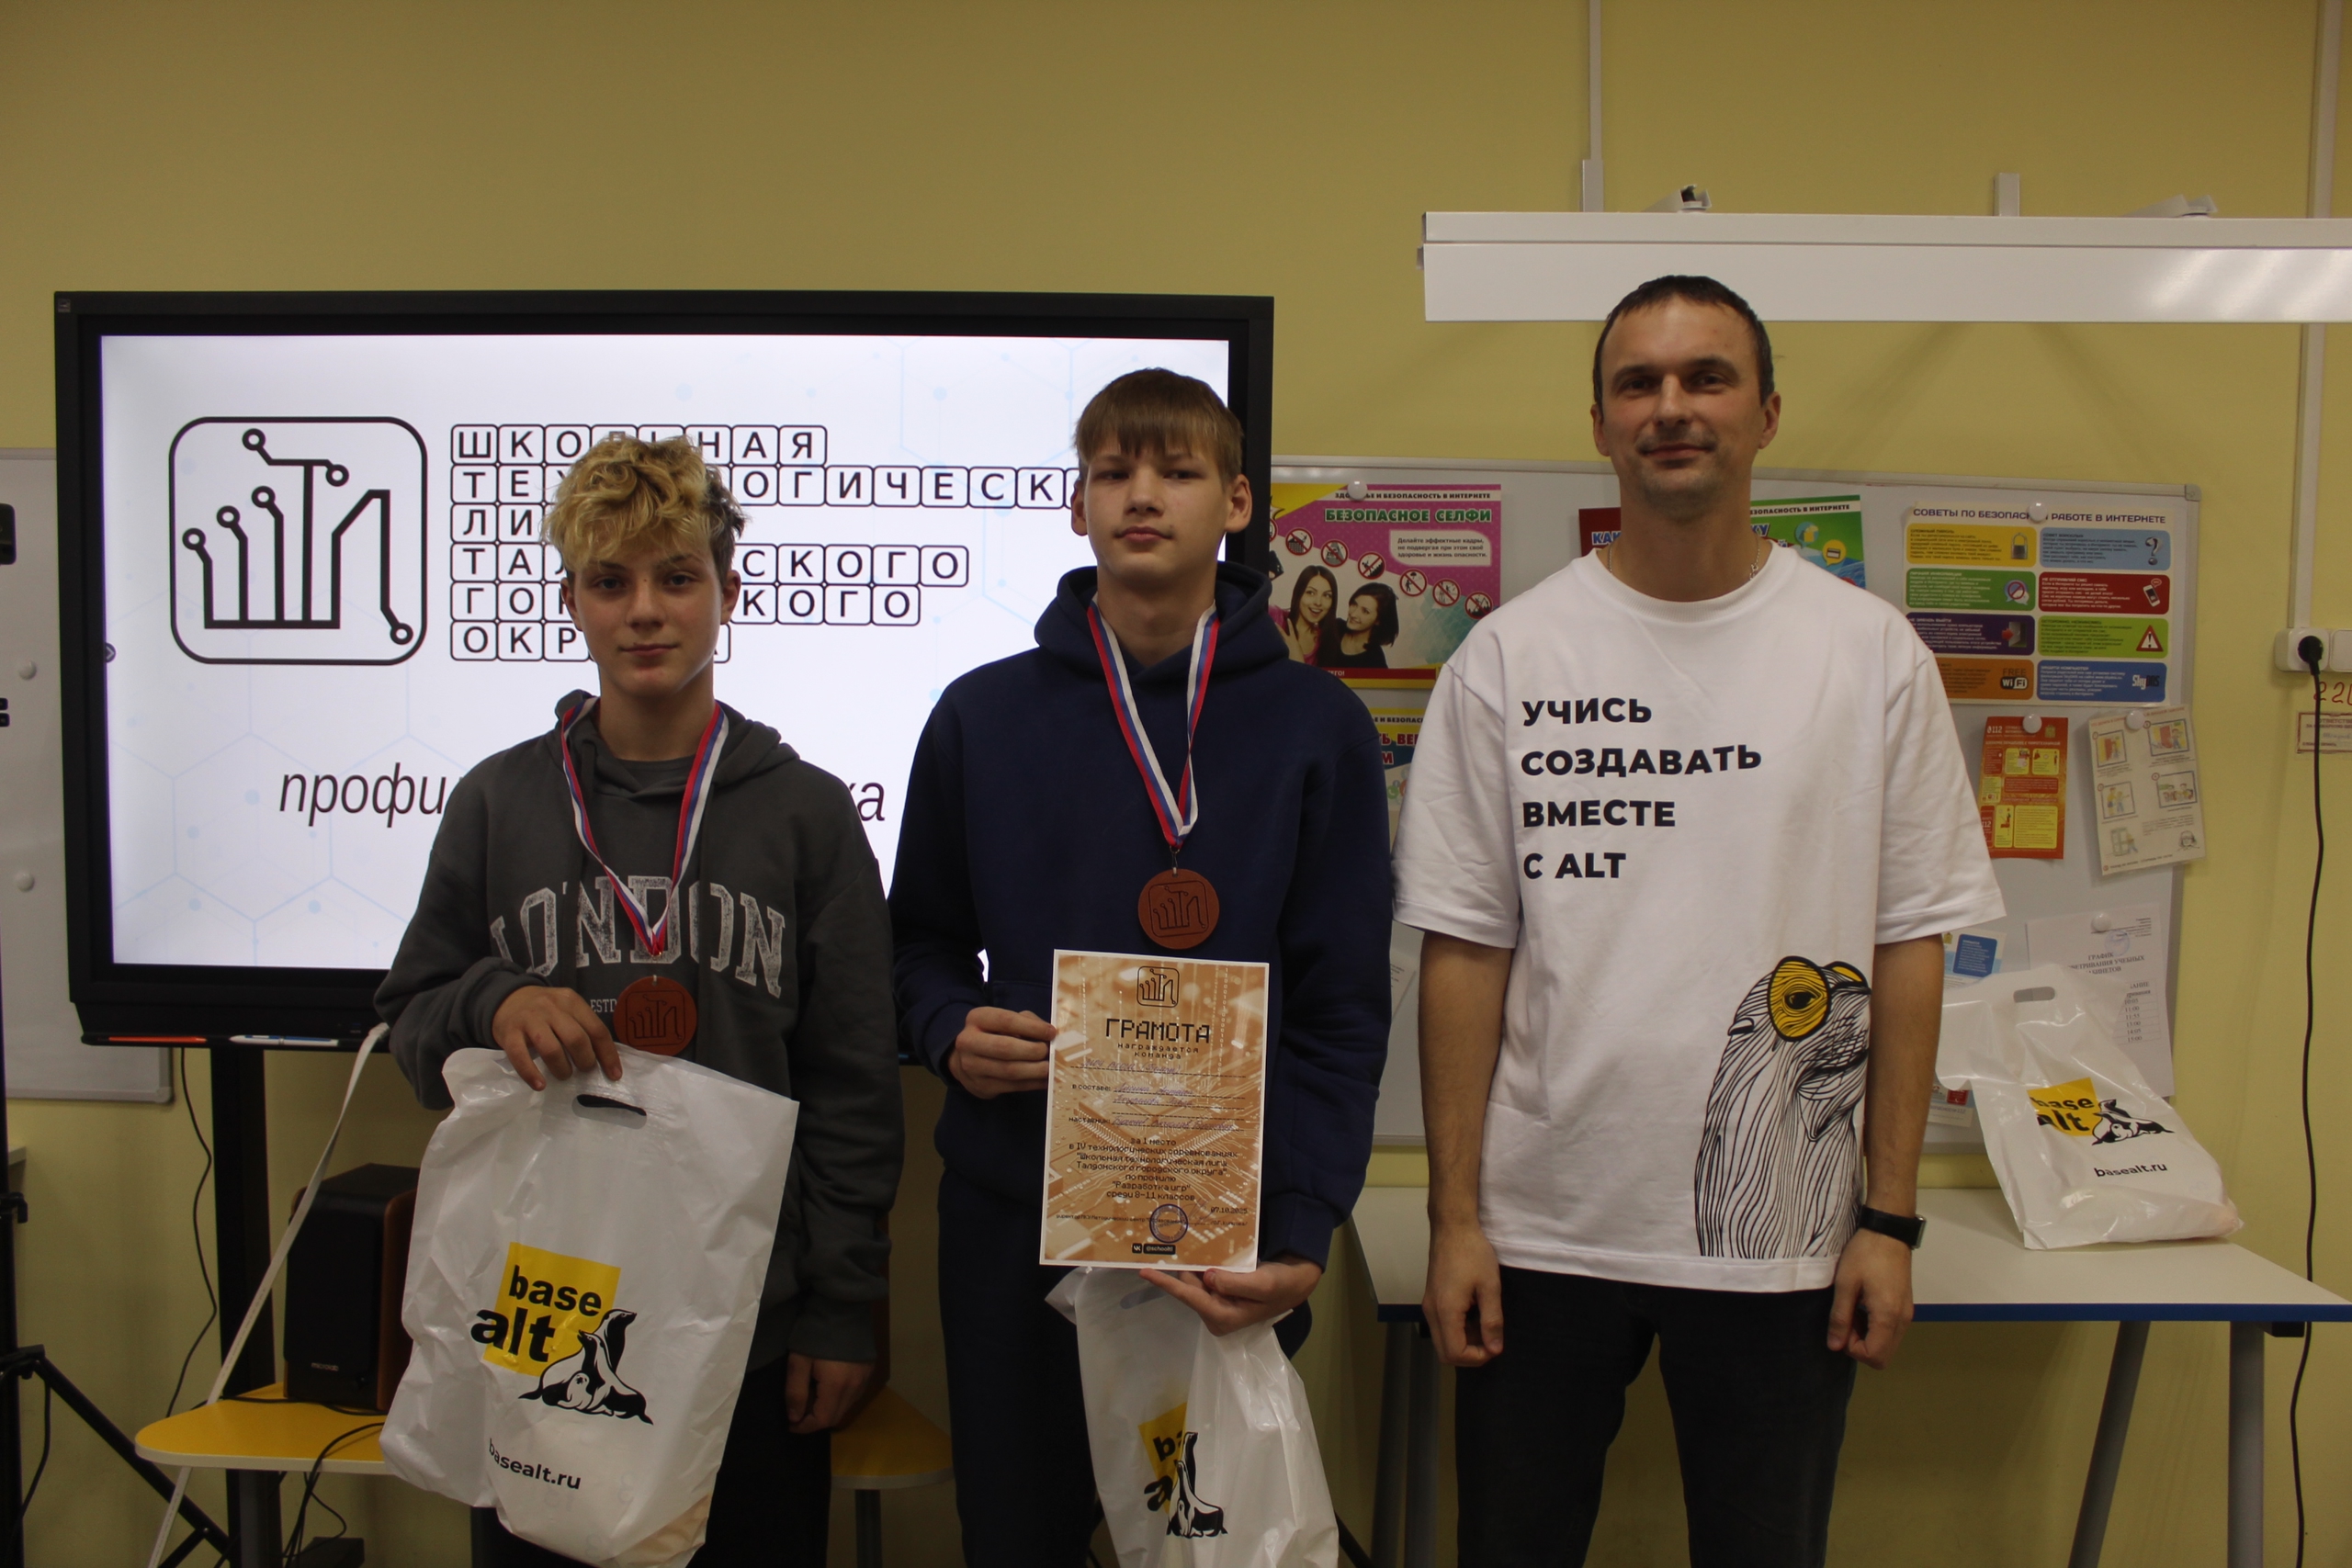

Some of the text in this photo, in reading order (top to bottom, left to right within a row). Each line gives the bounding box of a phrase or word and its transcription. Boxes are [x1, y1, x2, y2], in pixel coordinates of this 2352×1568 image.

[459, 431, 812, 459] ШКОНАЯ
[463, 470, 1053, 502] ТЕОГИЧЕСК
[1325, 509, 1491, 522] БЕЗОПАСНОЕ СЕЛФИ
[1913, 509, 1958, 517] СОВЕТЫ
[2052, 513, 2092, 522] РАБОТЕ
[2106, 514, 2165, 524] ИНТЕРНЕТЕ
[2003, 668, 2027, 676] FREE
[1521, 697, 1652, 727] УЧИСЬ
[1521, 744, 1762, 777] СОЗДАВАТЬ
[279, 763, 447, 828] профи
[1522, 799, 1676, 828] ВМЕСТЕ
[1523, 852, 1626, 879] С ALT
[2088, 953, 2114, 961] ГРАФИК
[2114, 955, 2145, 964] УЧЕБНЫХ
[1106, 1018, 1210, 1043] ГРАМОТА
[1118, 1043, 1199, 1053] награждается
[1135, 1052, 1181, 1060] команда
[2030, 1097, 2095, 1111] base
[1088, 1145, 1166, 1154] технологических
[1168, 1148, 1238, 1157] соревнованиях
[1136, 1166, 1189, 1174] городского
[2094, 1163, 2167, 1178] basealt.ru
[1135, 1190, 1156, 1199] 8-11
[508, 1265, 602, 1316] base
[470, 1307, 556, 1362] alt
[489, 1438, 581, 1489] basealt.ru
